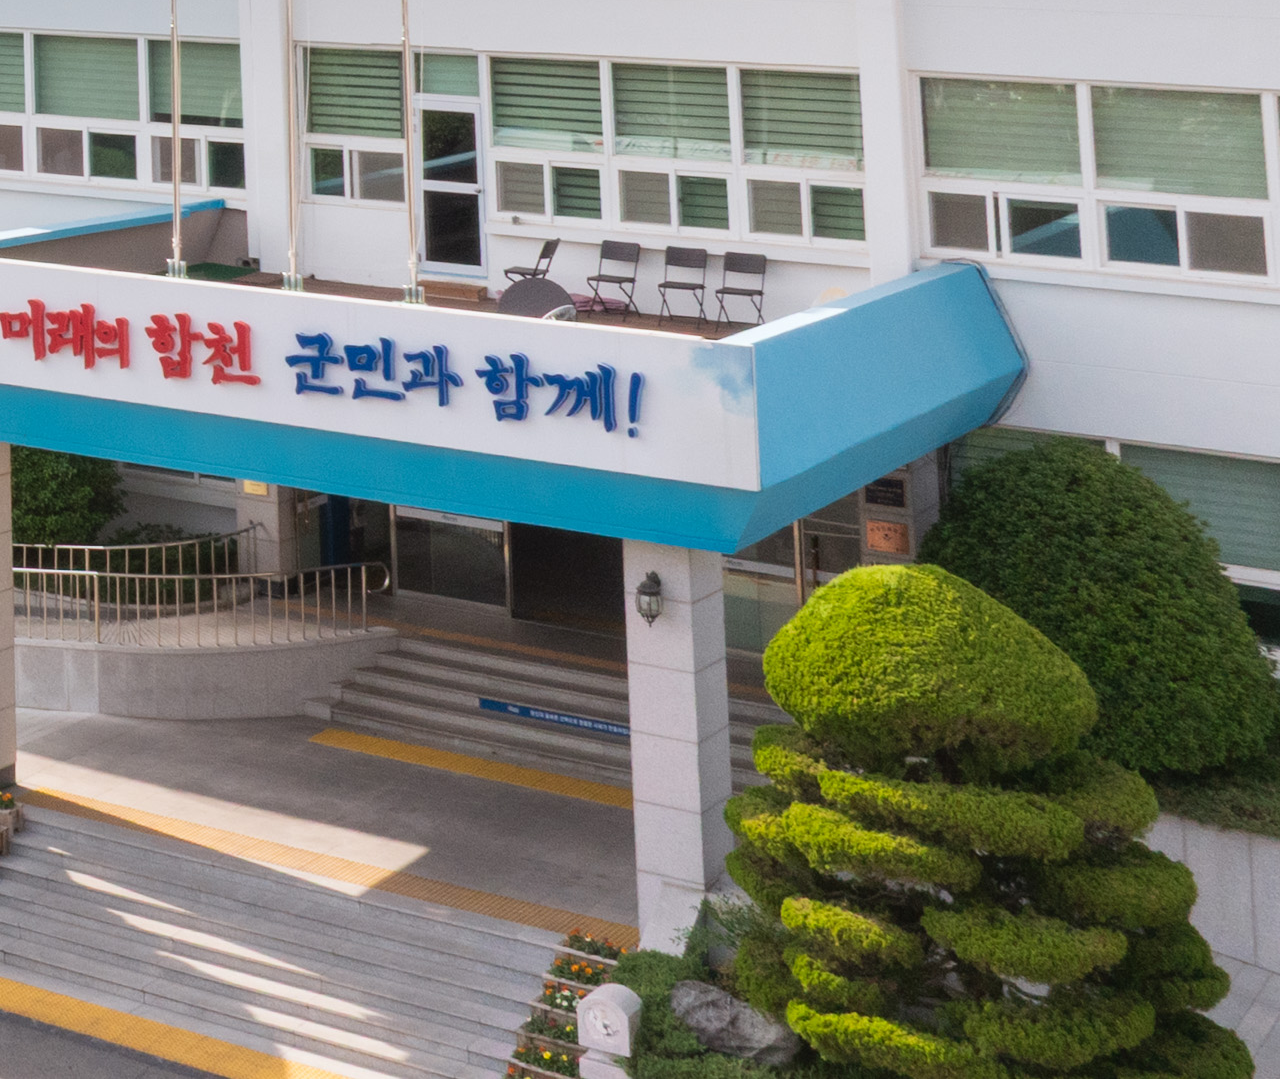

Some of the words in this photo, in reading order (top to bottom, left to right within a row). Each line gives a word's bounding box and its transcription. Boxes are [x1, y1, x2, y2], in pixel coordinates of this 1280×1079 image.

[145, 313, 261, 386] 합천
[285, 332, 464, 407] 군민과
[475, 352, 645, 438] 함께!
